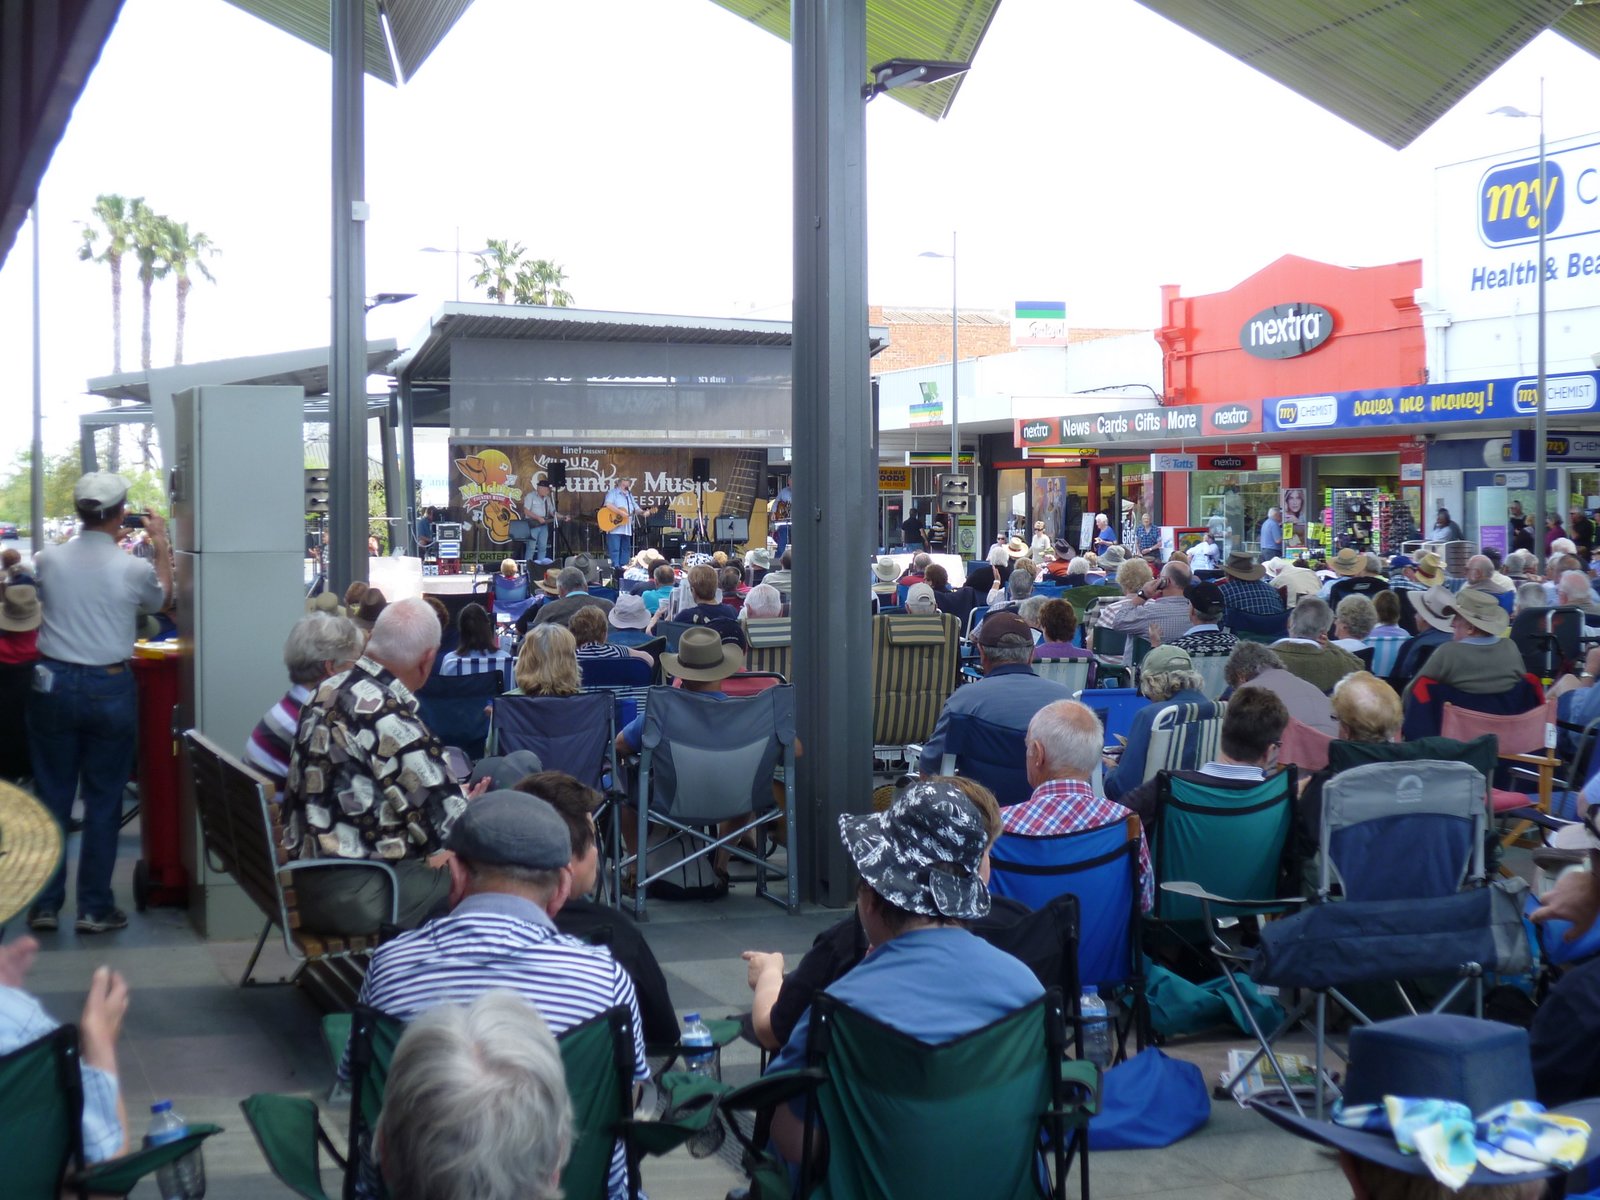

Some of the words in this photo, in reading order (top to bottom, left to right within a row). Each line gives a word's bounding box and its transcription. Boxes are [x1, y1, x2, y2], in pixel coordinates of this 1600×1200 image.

[1486, 176, 1559, 229] my
[1471, 260, 1538, 291] Health
[1544, 257, 1558, 282] &
[1250, 308, 1321, 346] nextra
[1354, 396, 1394, 416] saves
[1400, 395, 1425, 414] me
[1432, 383, 1494, 415] money!
[1547, 384, 1591, 400] CHEMIST
[1215, 407, 1249, 425] nextra
[1279, 406, 1297, 422] my
[1301, 403, 1333, 418] CHEMIST
[1023, 422, 1049, 438] nextra
[1063, 419, 1090, 437] News
[1096, 415, 1128, 434] Cards
[1134, 412, 1160, 432] Gifts
[1167, 411, 1197, 430] More
[1172, 458, 1194, 469] Tatts
[1214, 457, 1242, 467] nextra
[643, 471, 718, 493] Music
